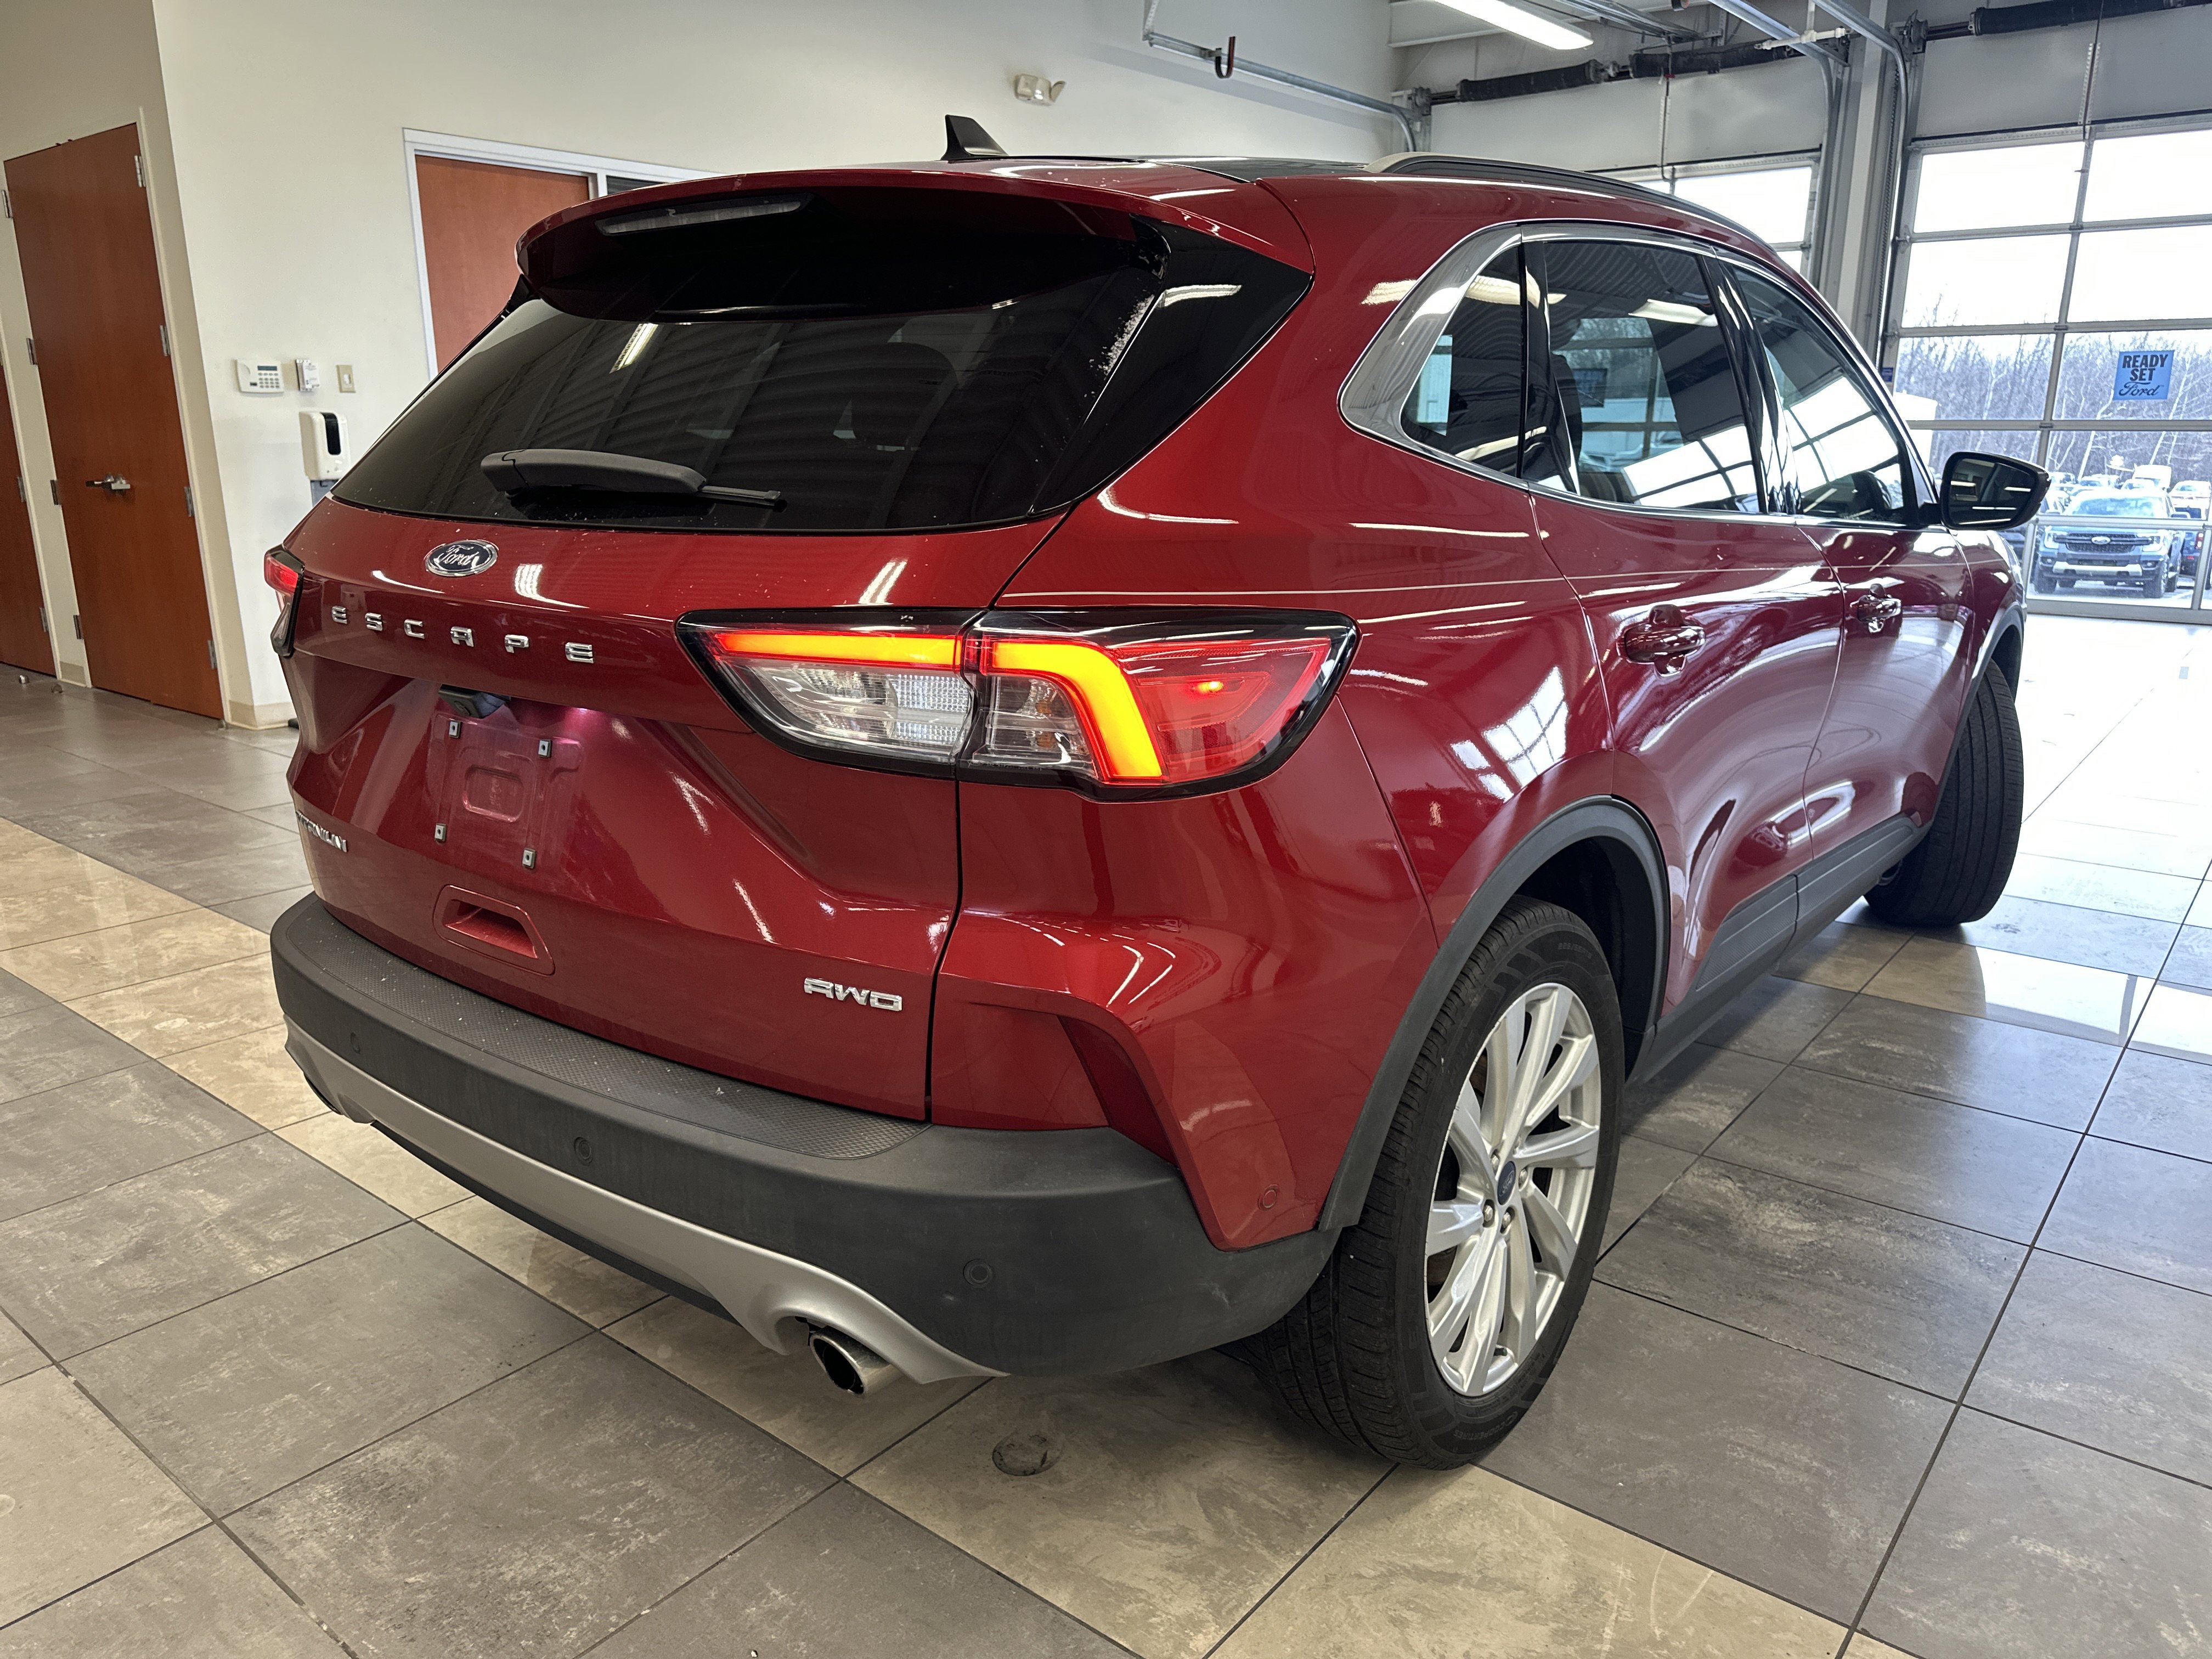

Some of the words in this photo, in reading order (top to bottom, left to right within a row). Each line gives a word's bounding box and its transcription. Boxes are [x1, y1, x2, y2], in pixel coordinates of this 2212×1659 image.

[2122, 354, 2169, 369] READY
[2130, 368, 2156, 381] SET
[2119, 381, 2161, 396] Ford
[433, 544, 479, 566] Ford
[331, 605, 594, 664] ESCAPE
[804, 978, 902, 1011] AWD
